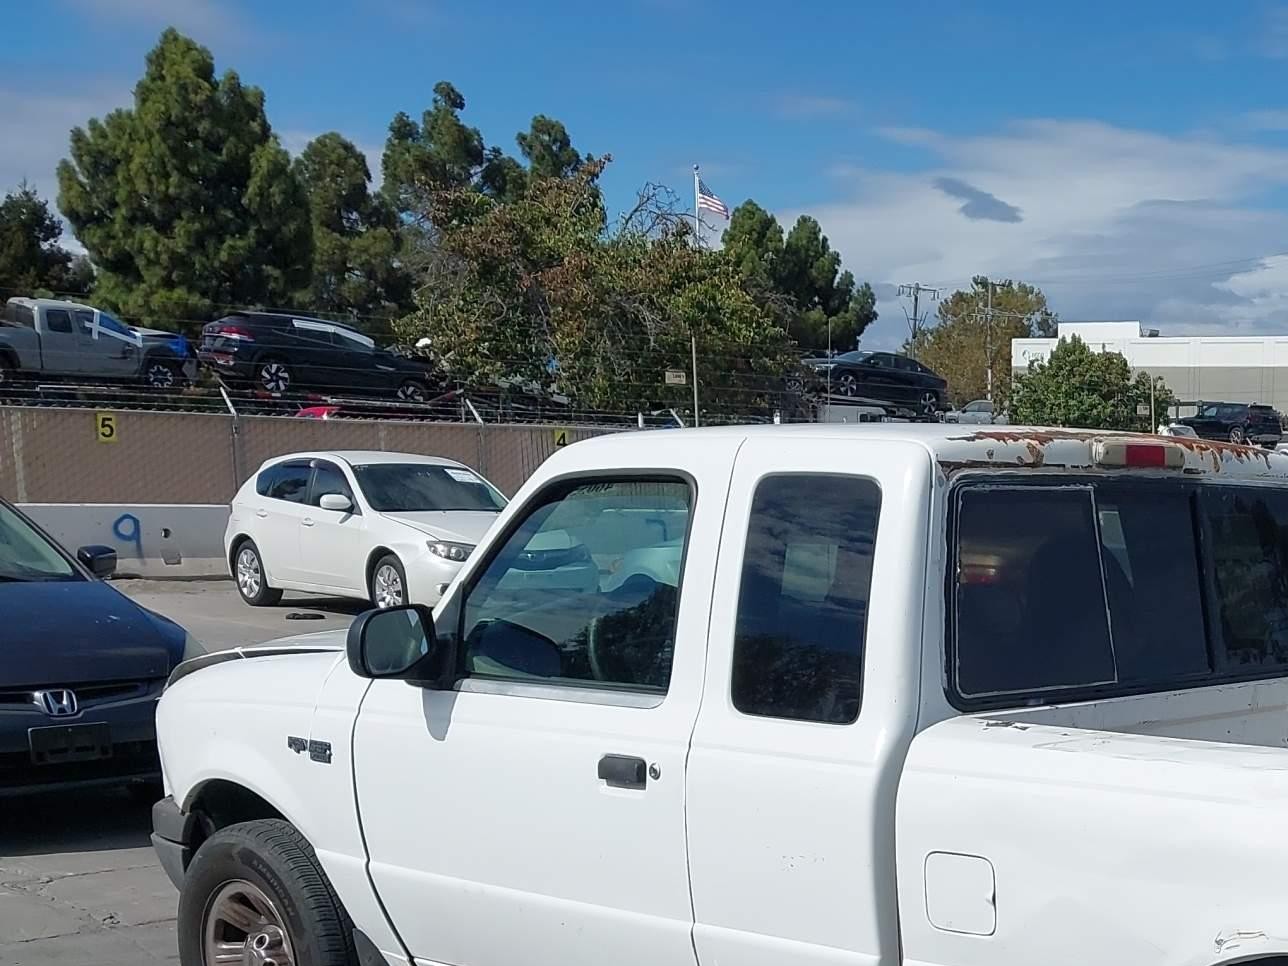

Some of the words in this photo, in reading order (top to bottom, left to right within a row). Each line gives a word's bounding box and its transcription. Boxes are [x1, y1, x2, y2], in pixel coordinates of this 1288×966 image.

[100, 417, 114, 438] 5
[556, 431, 568, 446] 4
[113, 513, 147, 566] 9
